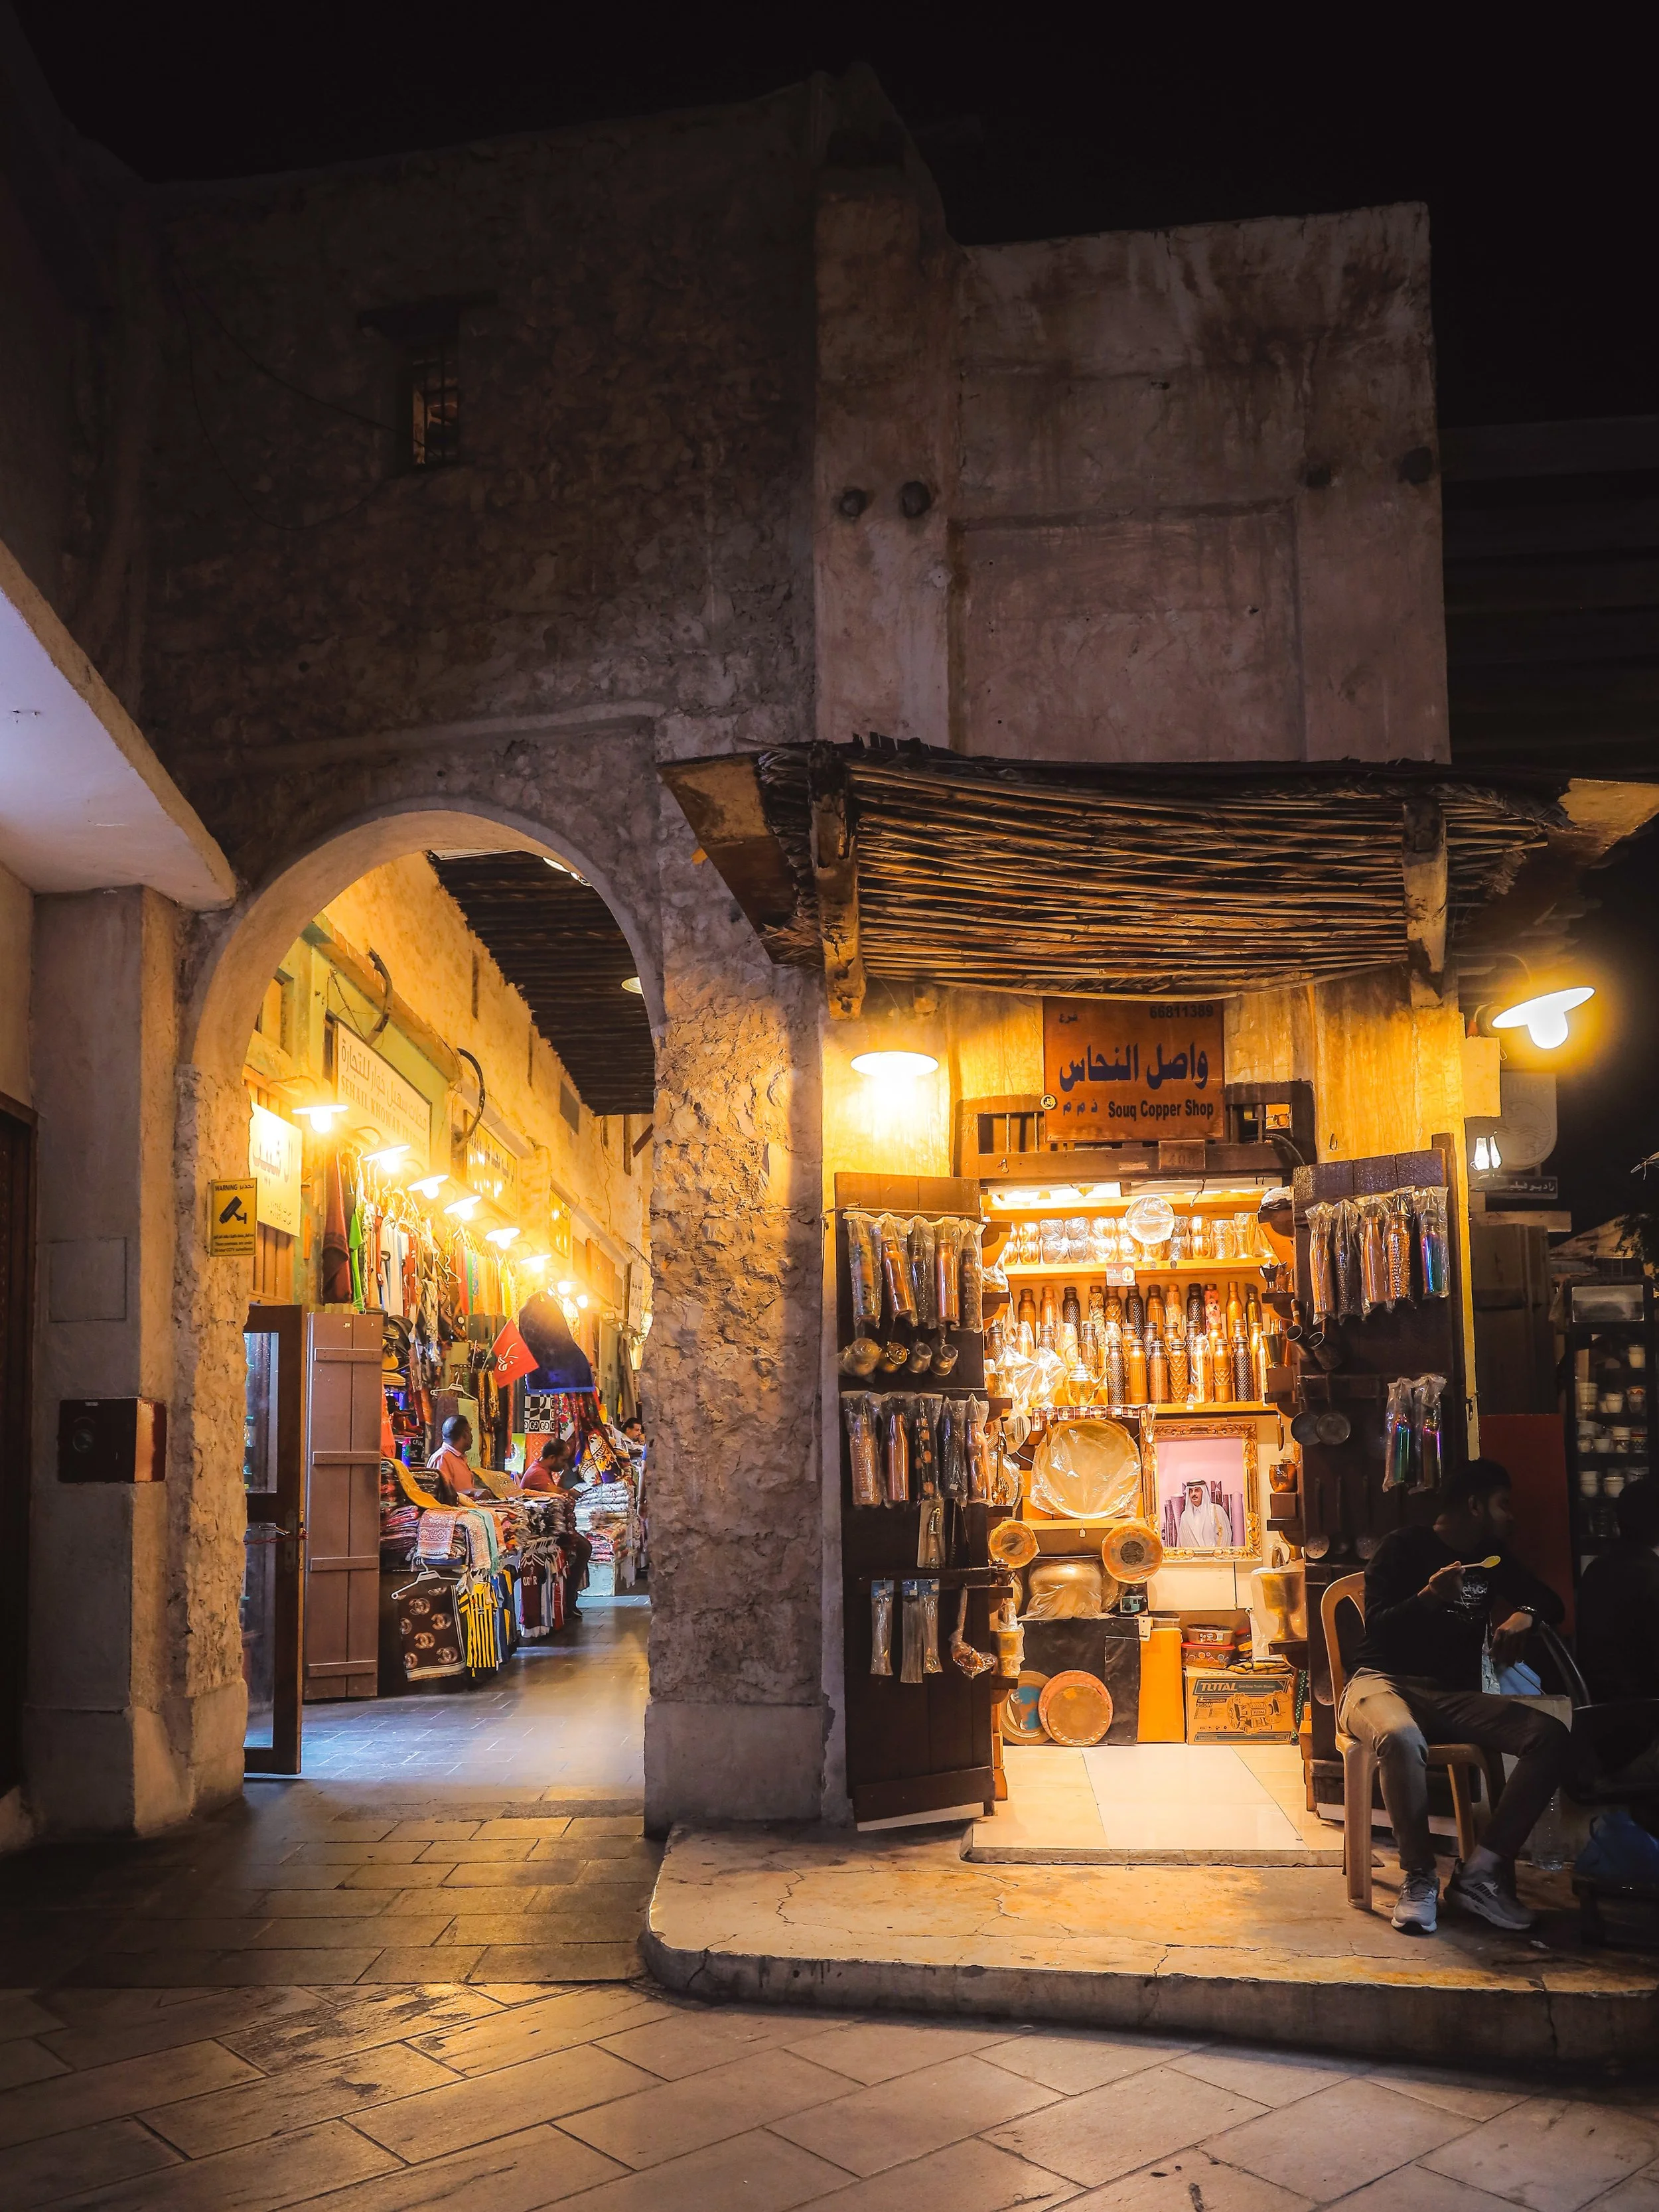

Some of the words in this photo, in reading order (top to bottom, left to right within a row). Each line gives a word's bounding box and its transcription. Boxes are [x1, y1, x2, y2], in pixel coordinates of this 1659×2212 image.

[1149, 1004, 1214, 1019] 66811389
[1059, 1043, 1139, 1092] النحاس
[1146, 1041, 1208, 1090] واصل
[1108, 1101, 1137, 1122] Souq
[1140, 1100, 1182, 1121] Copper
[1185, 1099, 1214, 1120] Shop
[1200, 1682, 1238, 1692] TOTAL
